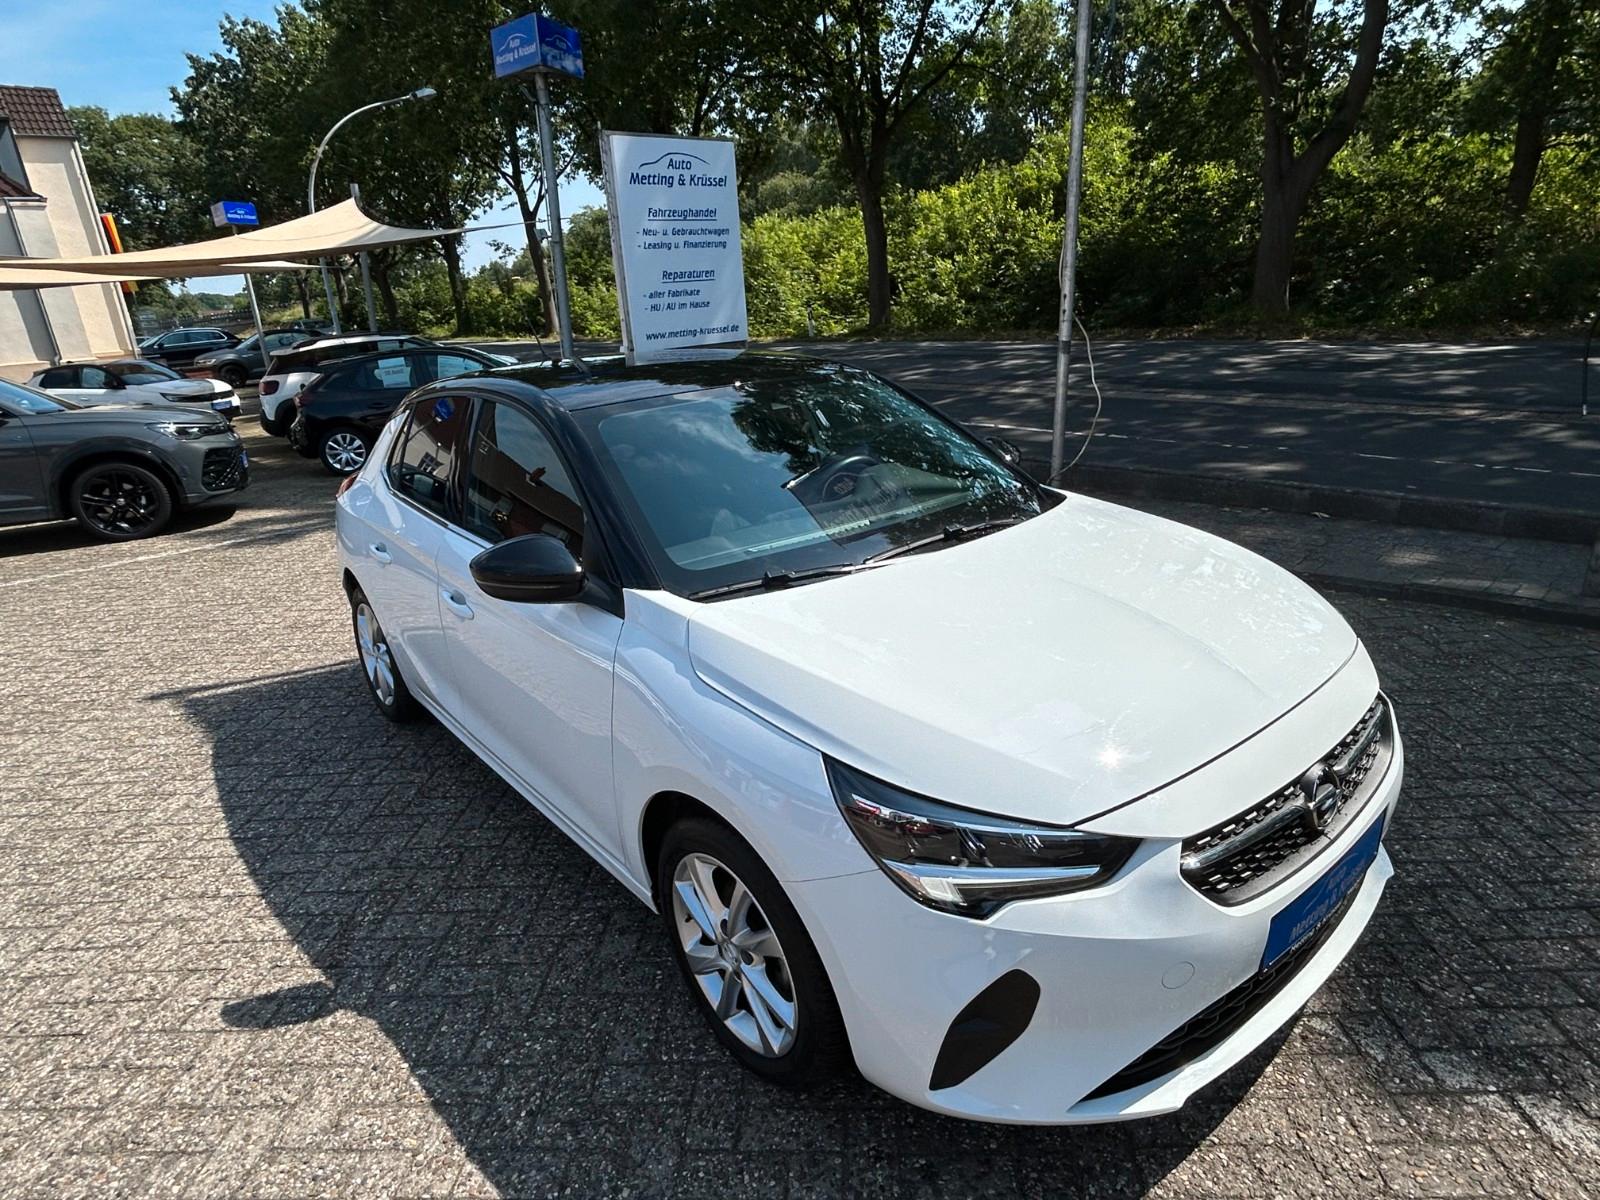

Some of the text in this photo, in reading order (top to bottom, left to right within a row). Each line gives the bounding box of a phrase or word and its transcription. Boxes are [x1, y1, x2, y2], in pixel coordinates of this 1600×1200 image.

[667, 158, 692, 170] Auto
[629, 172, 728, 188] Metting & Krüssel
[647, 207, 718, 220] Fahrzeughandel
[642, 228, 661, 236] Neu-
[671, 227, 730, 237] Gebrauchtwagen
[643, 241, 672, 250] Leasing
[683, 241, 727, 249] Finanzierung
[661, 269, 715, 281] Reparaturen
[648, 290, 665, 299] aller
[667, 289, 701, 298] Fabrikate
[650, 303, 661, 312] HU
[678, 302, 688, 310] im
[689, 301, 711, 309] Hause
[645, 324, 740, 341] www.metting-kruessel.de
